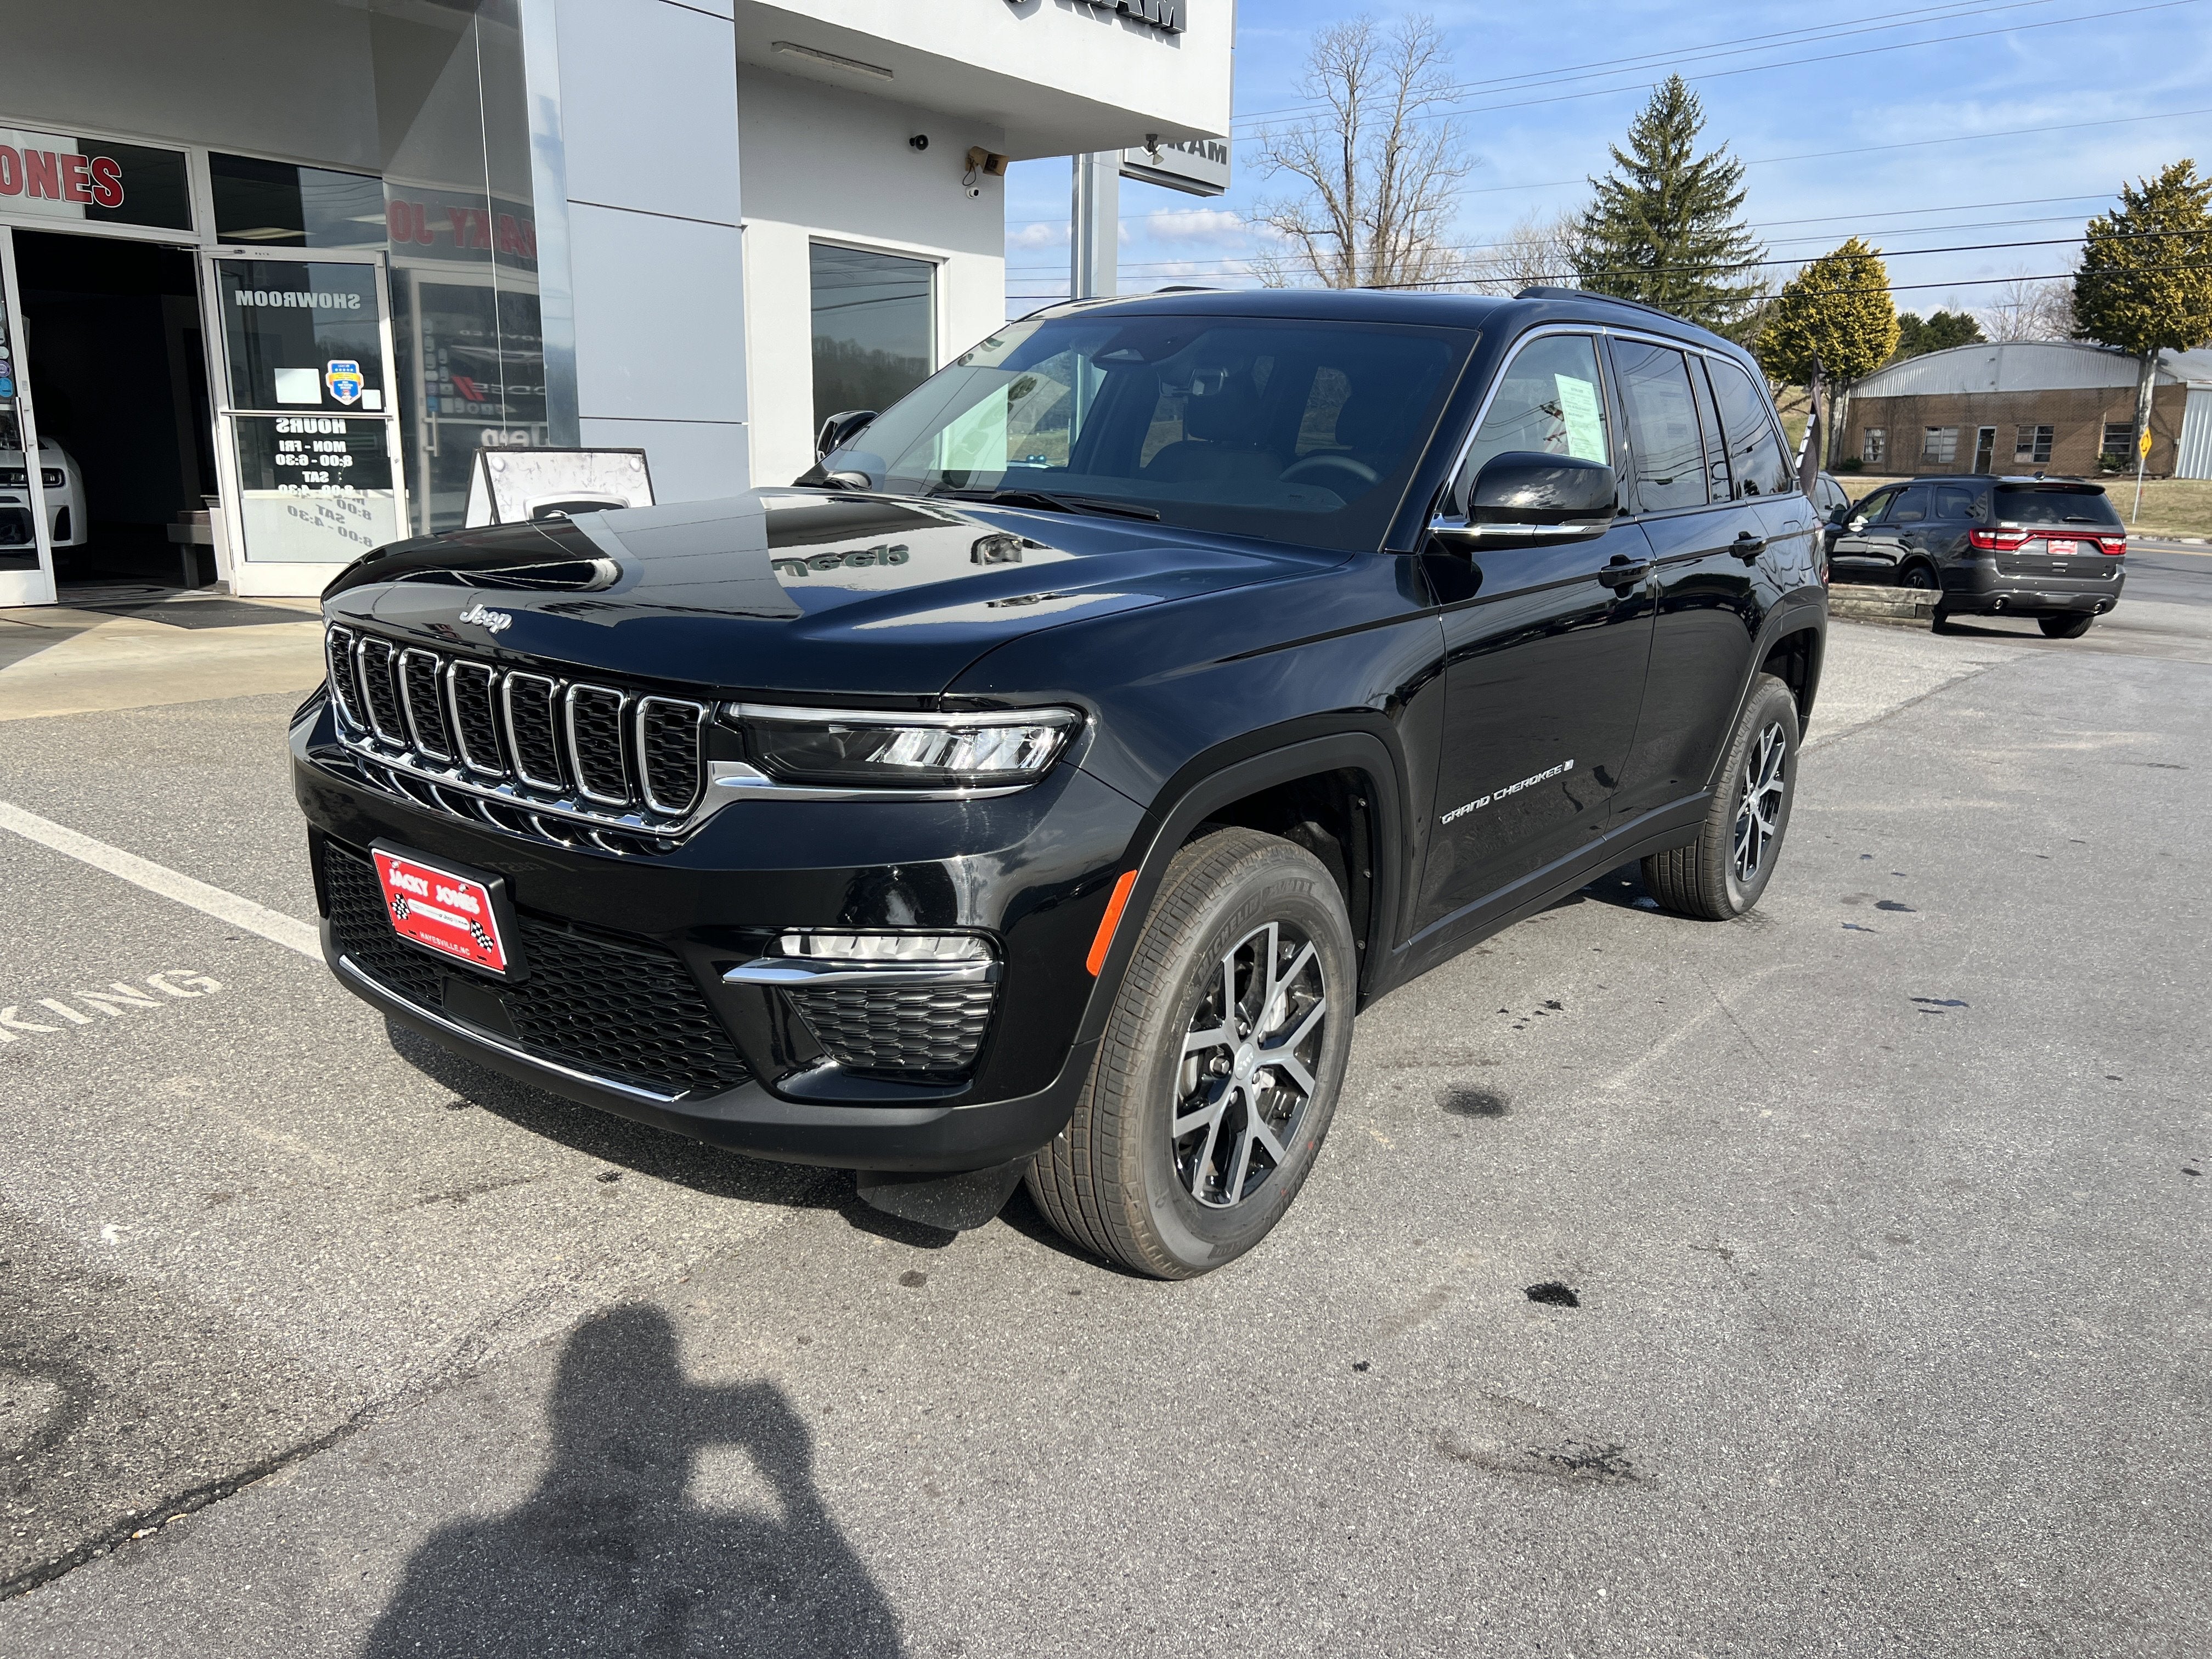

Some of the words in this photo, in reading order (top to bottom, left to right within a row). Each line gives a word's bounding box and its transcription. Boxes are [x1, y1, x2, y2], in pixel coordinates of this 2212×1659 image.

[460, 603, 513, 635] Jeep
[1440, 795, 1491, 825] GRAND
[1492, 764, 1563, 801] CHEROKEE
[389, 869, 428, 896] JACKY
[436, 884, 481, 915] JONES
[1198, 895, 1260, 981] MICHELIN
